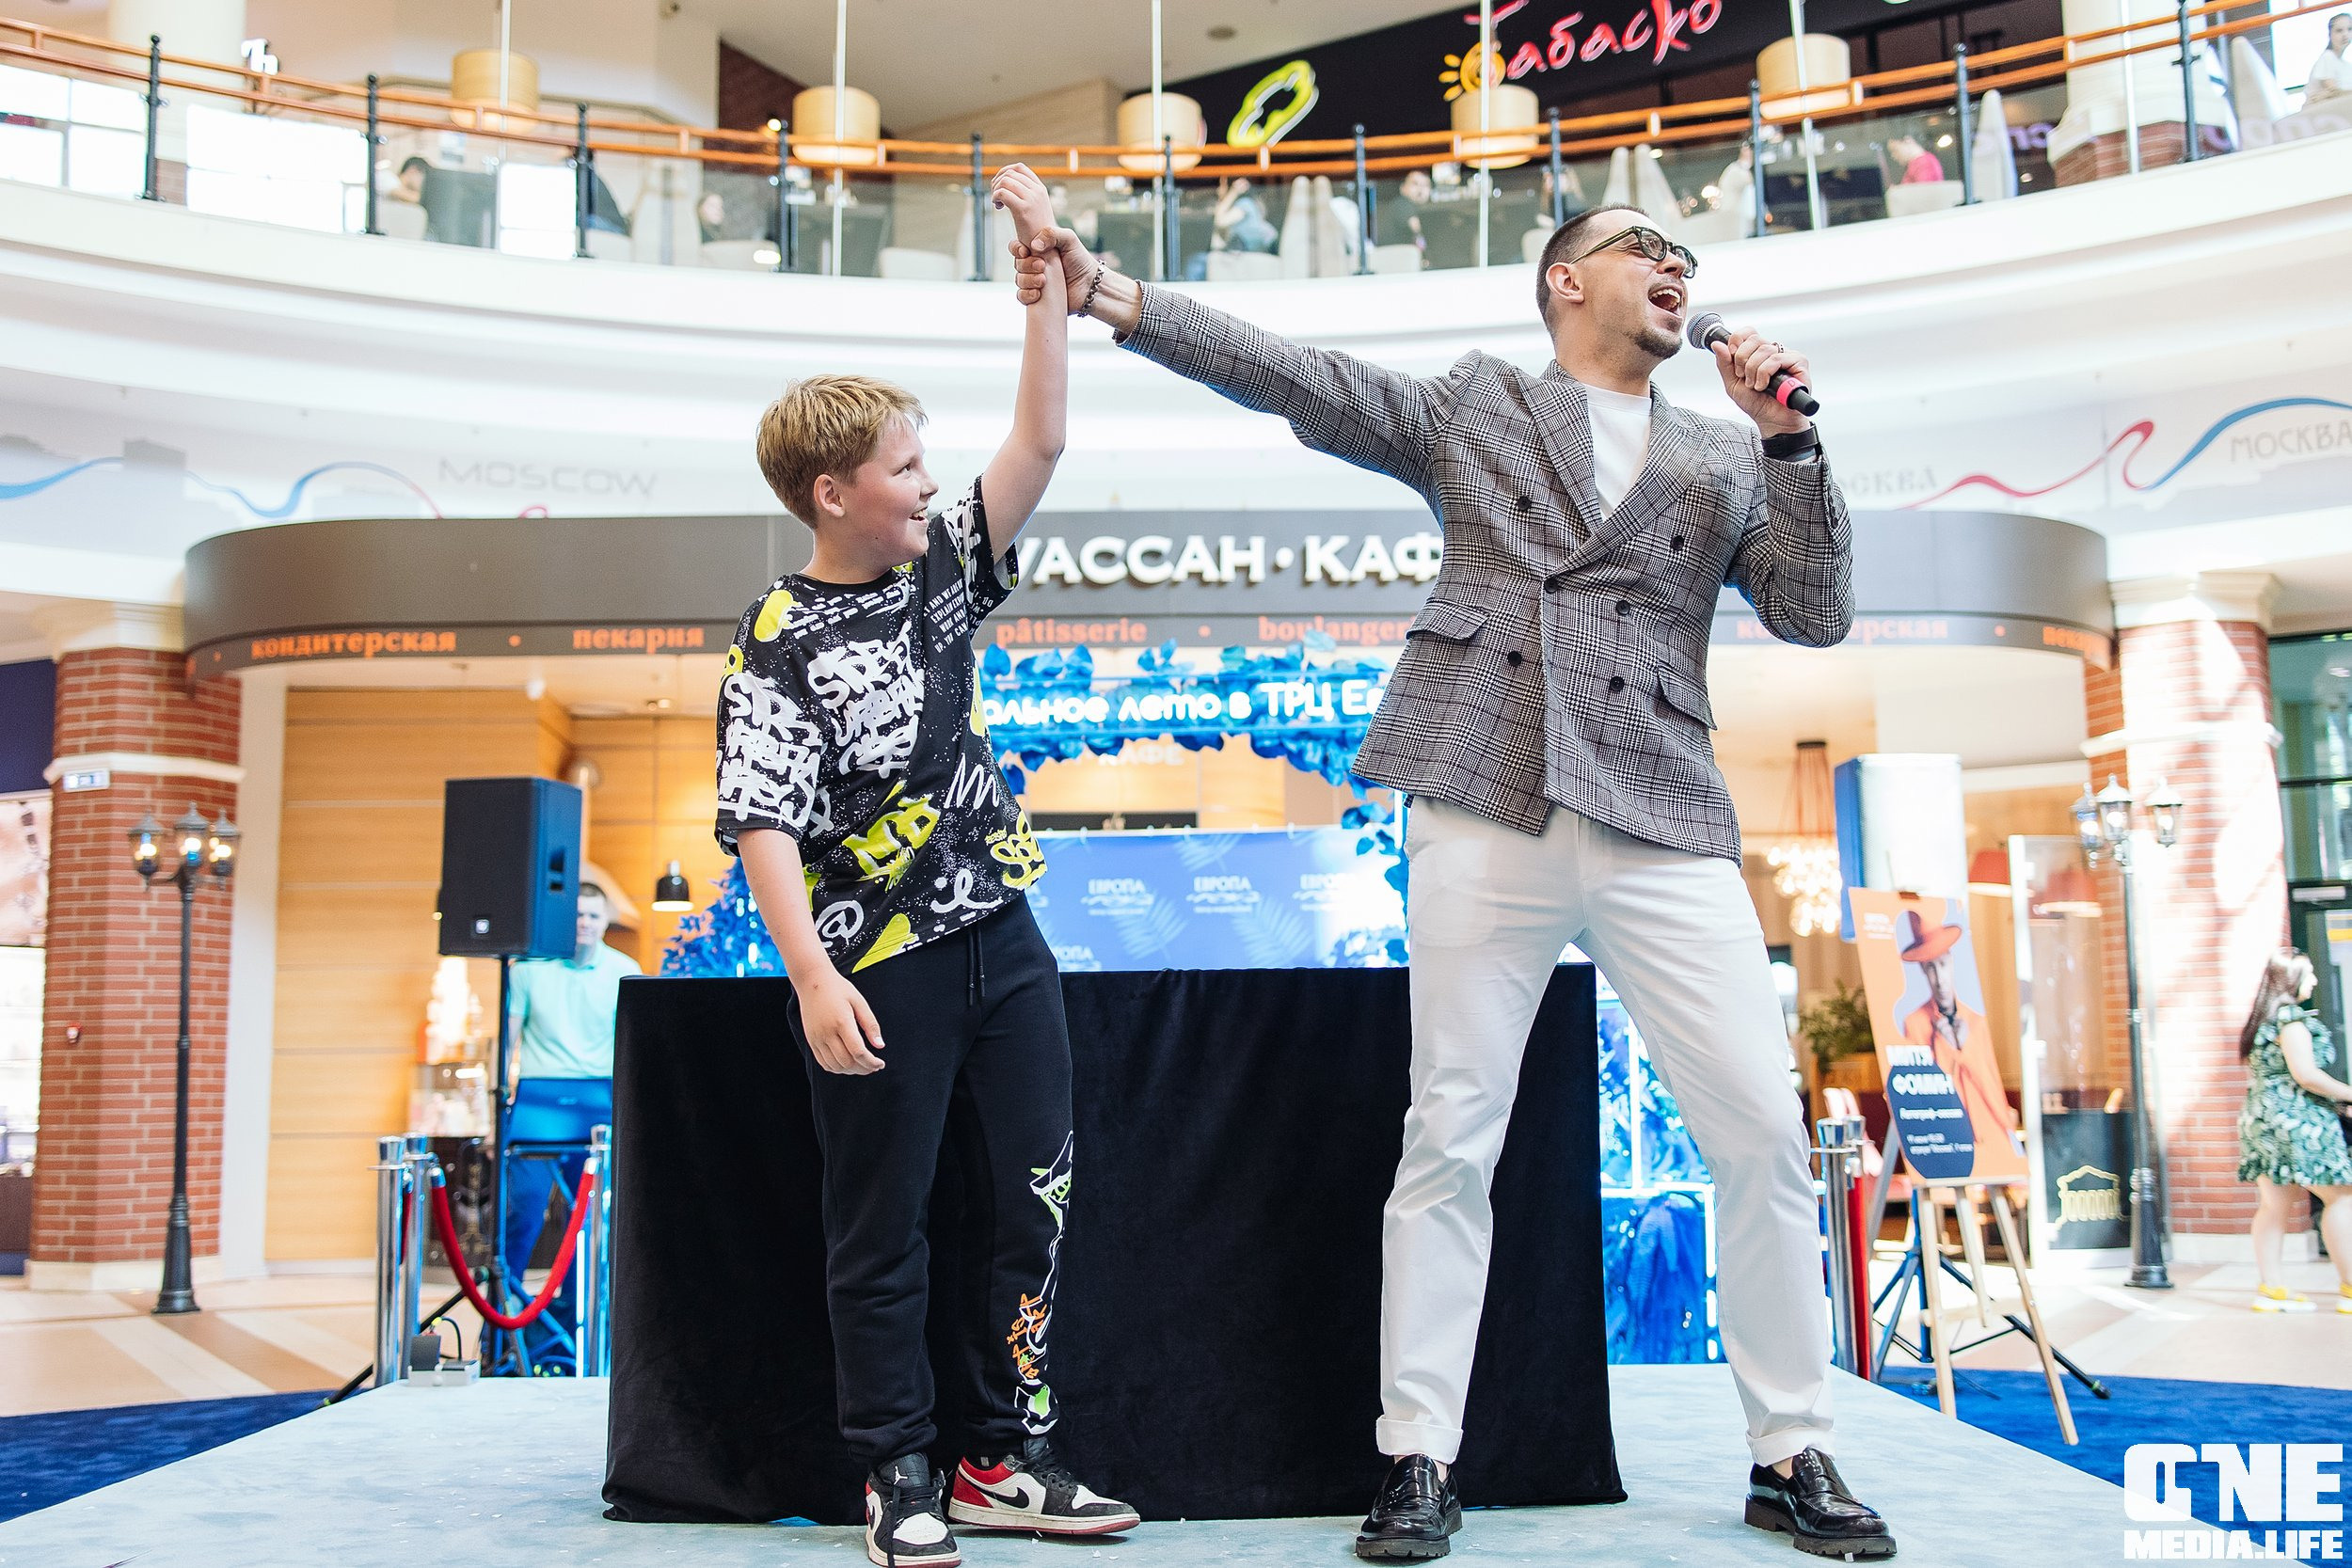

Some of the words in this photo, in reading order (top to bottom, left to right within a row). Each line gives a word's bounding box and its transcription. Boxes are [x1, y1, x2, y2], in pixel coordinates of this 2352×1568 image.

[2230, 420, 2352, 463] МОСКВА
[438, 458, 657, 497] MOSCOW
[251, 631, 456, 660] кондитерская
[573, 629, 704, 656] пекарня
[996, 617, 1147, 648] pâtisserie
[1118, 693, 1222, 721] лето
[1229, 691, 1252, 720] в
[1258, 681, 1335, 721] ТРЦ
